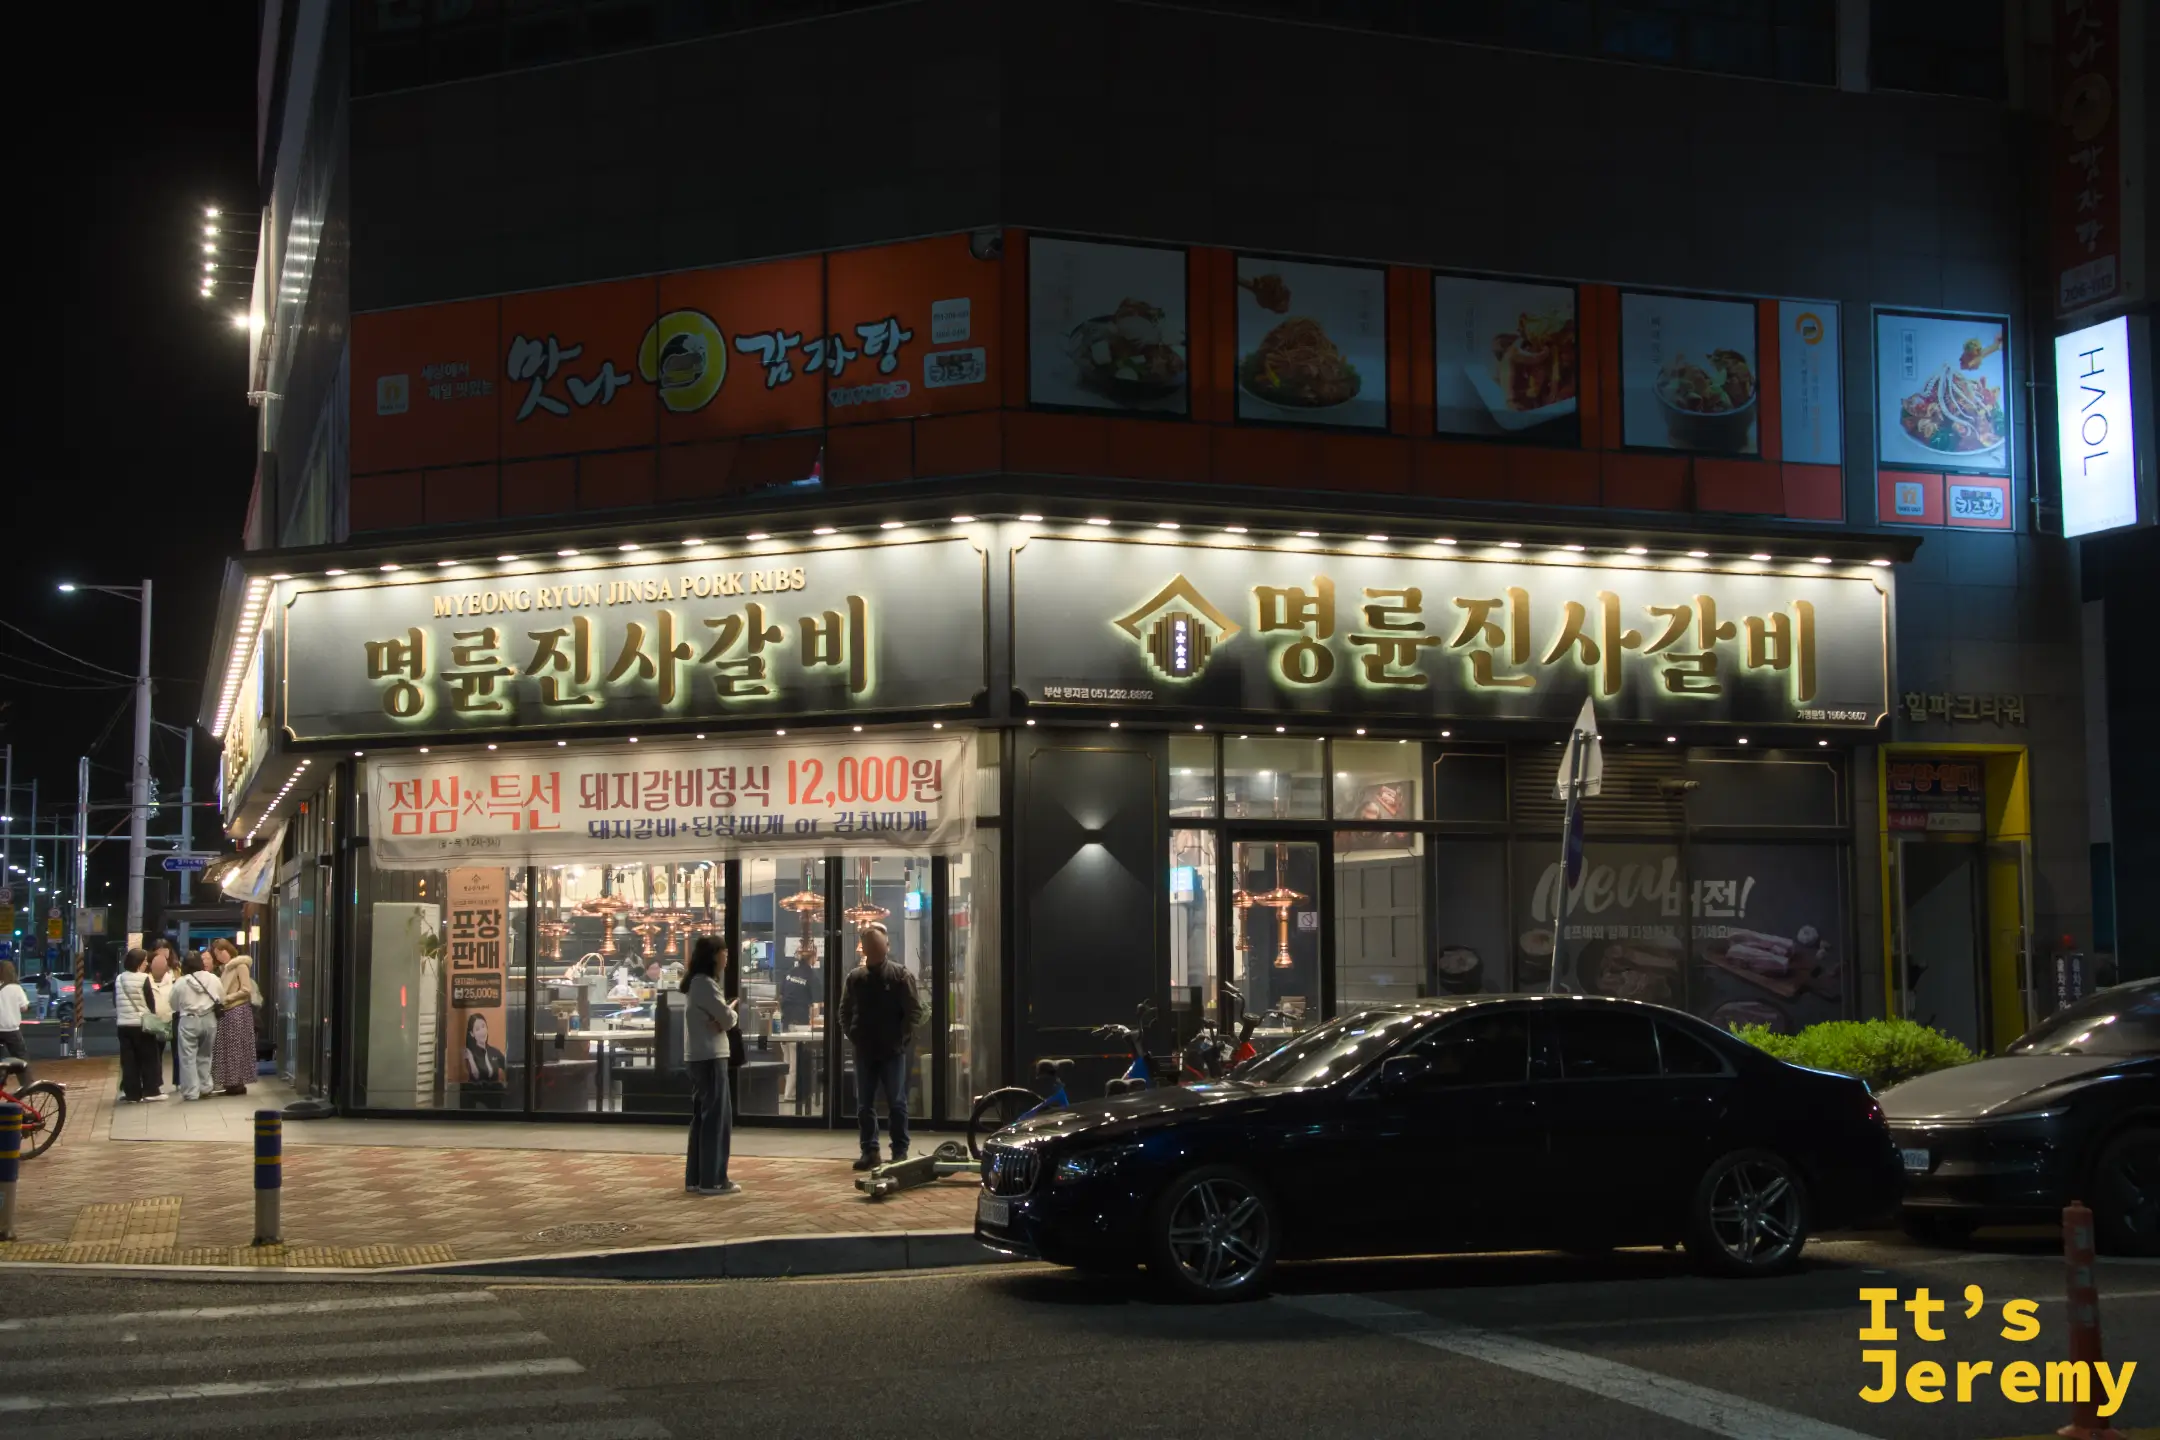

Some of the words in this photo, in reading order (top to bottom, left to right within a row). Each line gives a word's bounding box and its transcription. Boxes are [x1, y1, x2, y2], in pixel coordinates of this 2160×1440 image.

[506, 333, 634, 424] 맛나
[735, 316, 913, 389] 감자탕
[433, 590, 531, 617] MYEONG
[537, 583, 602, 609] RYUN
[606, 577, 673, 605] JINSA
[680, 572, 745, 598] PORK
[750, 567, 806, 592] RIBS
[364, 594, 872, 718] 명륜진사갈비
[1251, 574, 1817, 702] 명륜진사갈비
[388, 775, 459, 836] 점심
[486, 771, 561, 831] 특선
[578, 766, 770, 812] 돼지갈비정식
[787, 756, 944, 809] 12,000원
[587, 814, 785, 840] 돼지갈비+된장찌개
[794, 817, 833, 835] or
[831, 810, 928, 835] 김치찌개
[1531, 855, 1678, 922] New
[452, 908, 502, 939] 포장
[451, 940, 501, 970] 판매
